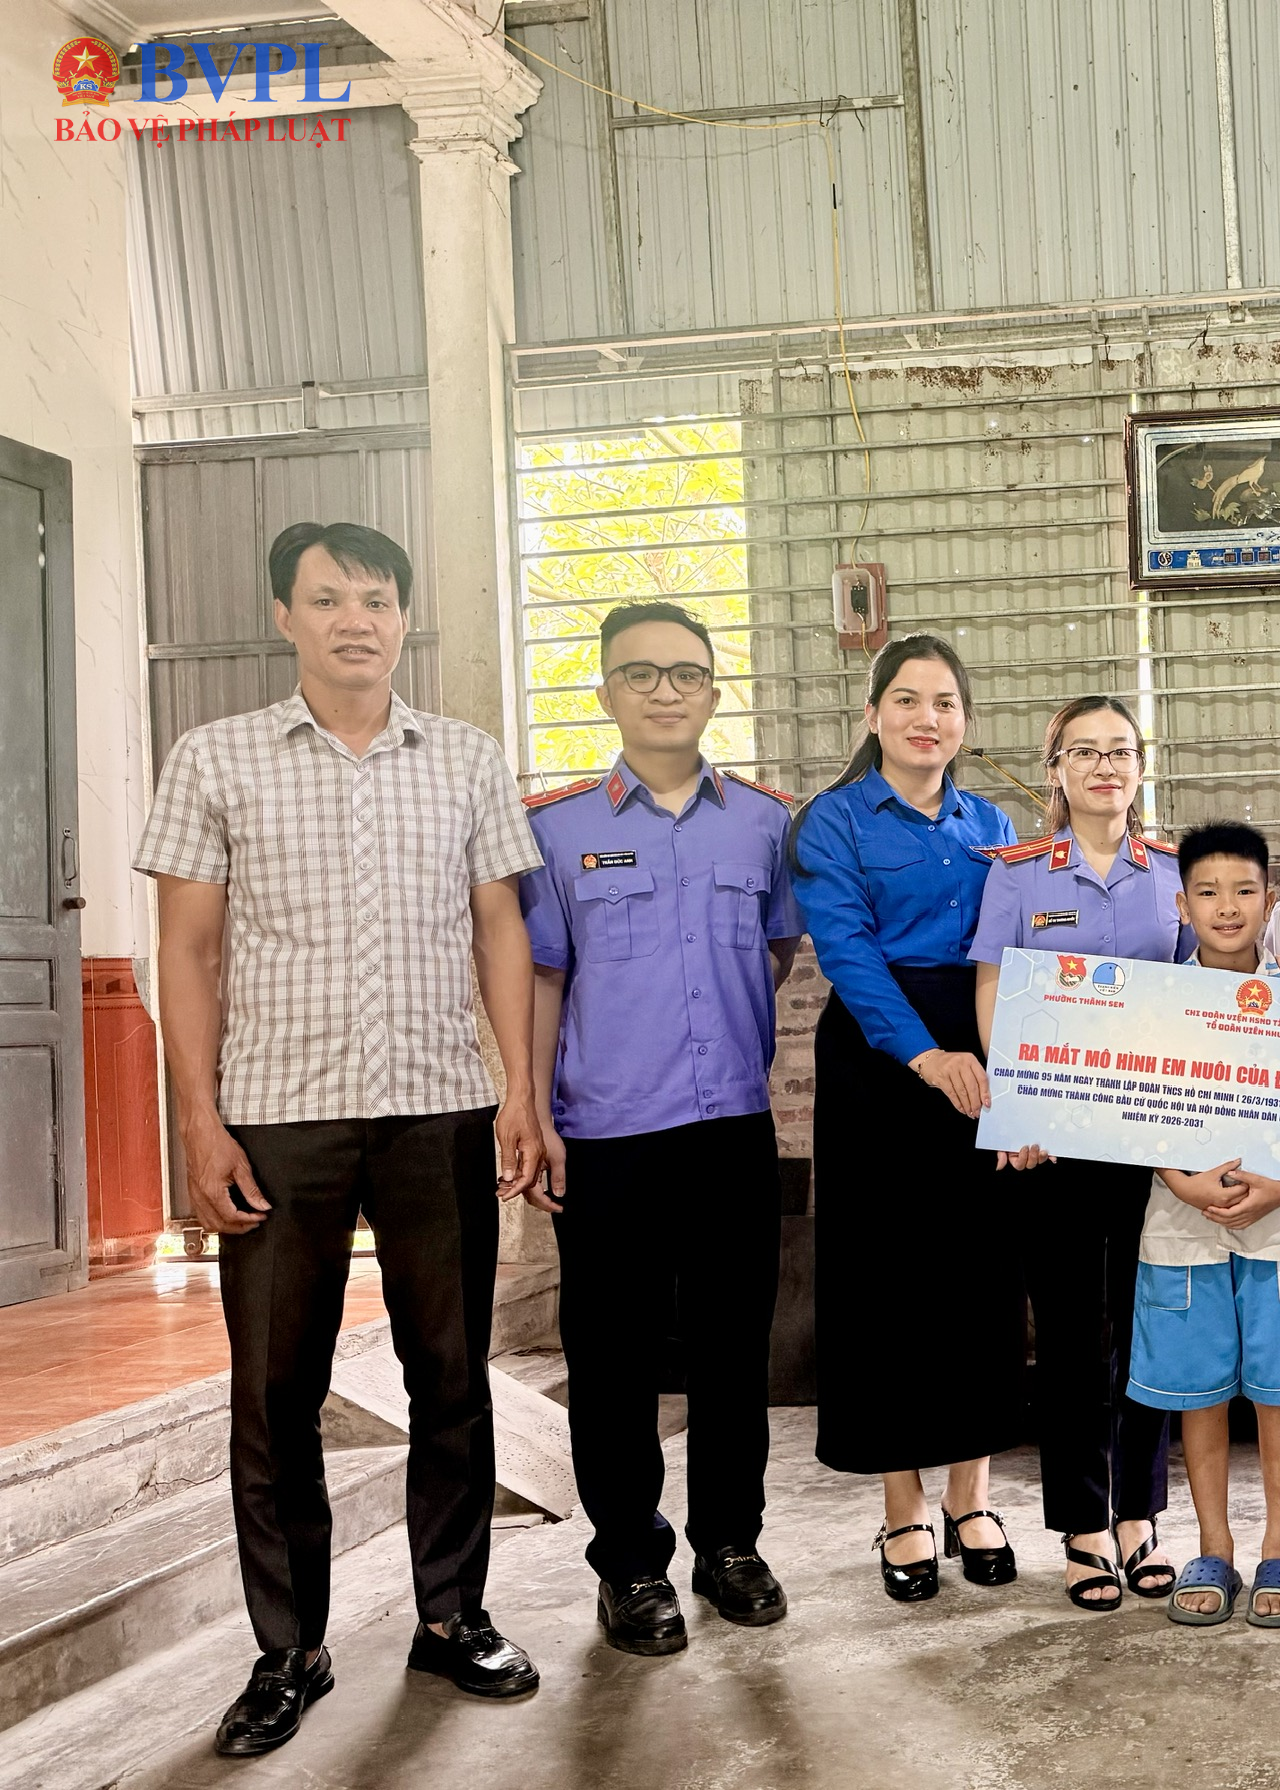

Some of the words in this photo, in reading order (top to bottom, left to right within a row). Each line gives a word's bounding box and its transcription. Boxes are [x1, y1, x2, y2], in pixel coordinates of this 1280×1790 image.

[1043, 994, 1077, 1003] PHƯỜNG
[1108, 1000, 1124, 1008] SEN
[1201, 1010, 1225, 1019] ĐOÀN
[1205, 1019, 1217, 1029] TỔ
[1018, 1043, 1040, 1061] RA
[1043, 1043, 1080, 1065] MẮT
[1083, 1049, 1111, 1068] MÔ
[1115, 1052, 1157, 1073] HÌNH
[1161, 1057, 1186, 1076] EM
[1190, 1060, 1231, 1081] NUÔI
[1235, 1064, 1269, 1087] CỦA
[1041, 1072, 1051, 1081] 95
[1122, 1079, 1137, 1090] LẬP
[1138, 1081, 1160, 1093] ĐOÀN
[1162, 1084, 1182, 1096] TNCS
[1197, 1089, 1211, 1099] CHÍ
[1213, 1091, 1234, 1101] MINH
[1092, 1092, 1113, 1103] CÔNG
[1170, 1100, 1184, 1111] HỘI
[1186, 1103, 1196, 1112] VÀ
[1198, 1103, 1212, 1114] HỘI
[1214, 1104, 1236, 1116] ĐỒNG
[1237, 1109, 1259, 1119] NHÂN
[1261, 1111, 1277, 1121] DÂN
[1121, 1111, 1146, 1121] NHIỆM
[1160, 1115, 1203, 1128] 2026-2031
